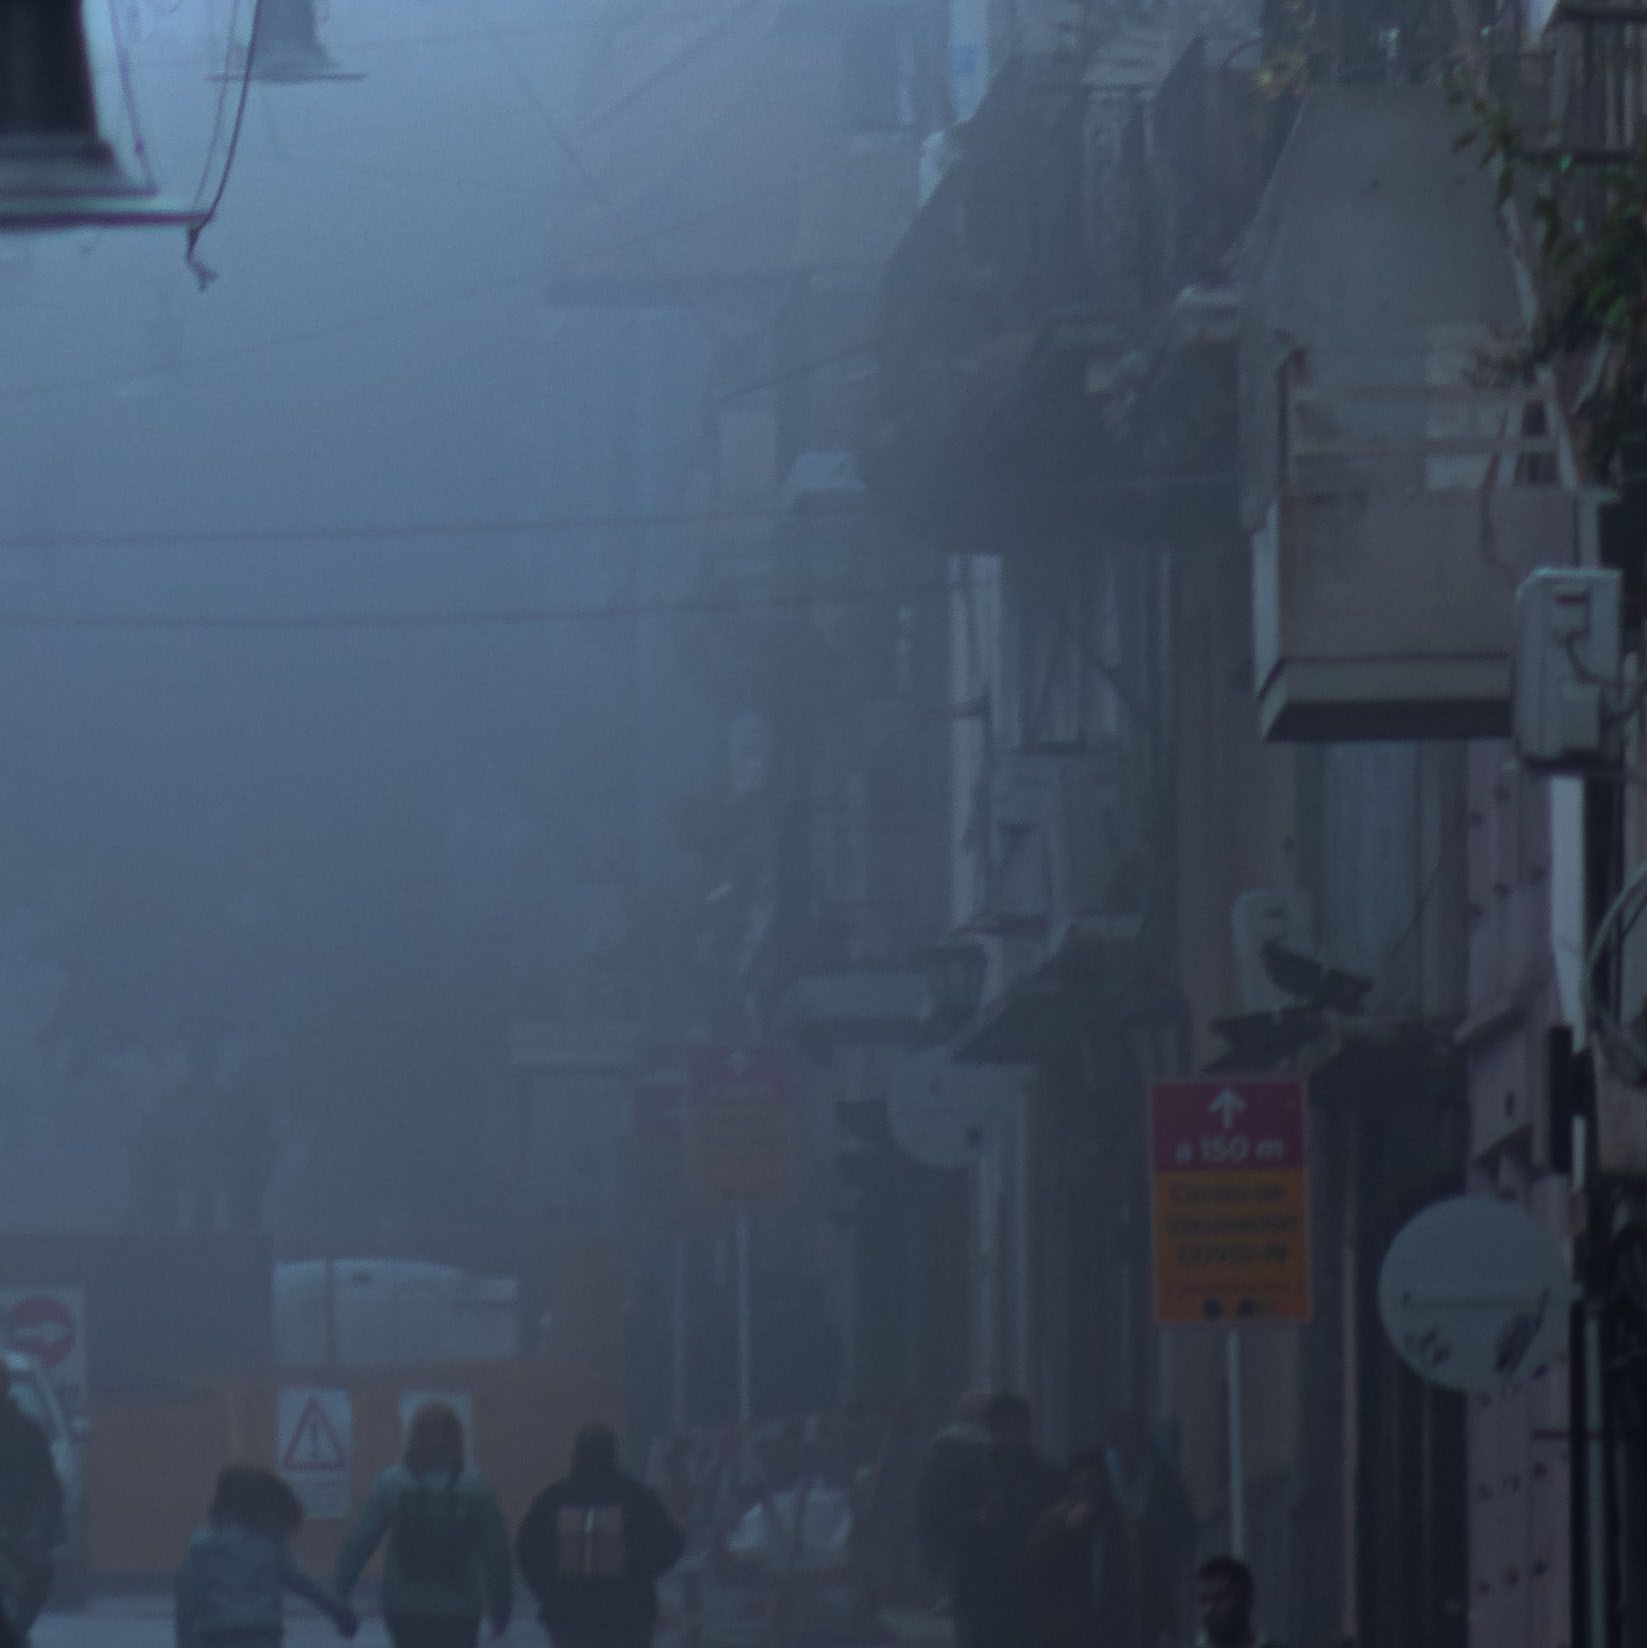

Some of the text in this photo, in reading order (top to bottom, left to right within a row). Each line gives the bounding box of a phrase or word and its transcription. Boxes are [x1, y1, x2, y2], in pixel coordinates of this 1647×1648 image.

[1175, 1135, 1284, 1164] a 150 m
